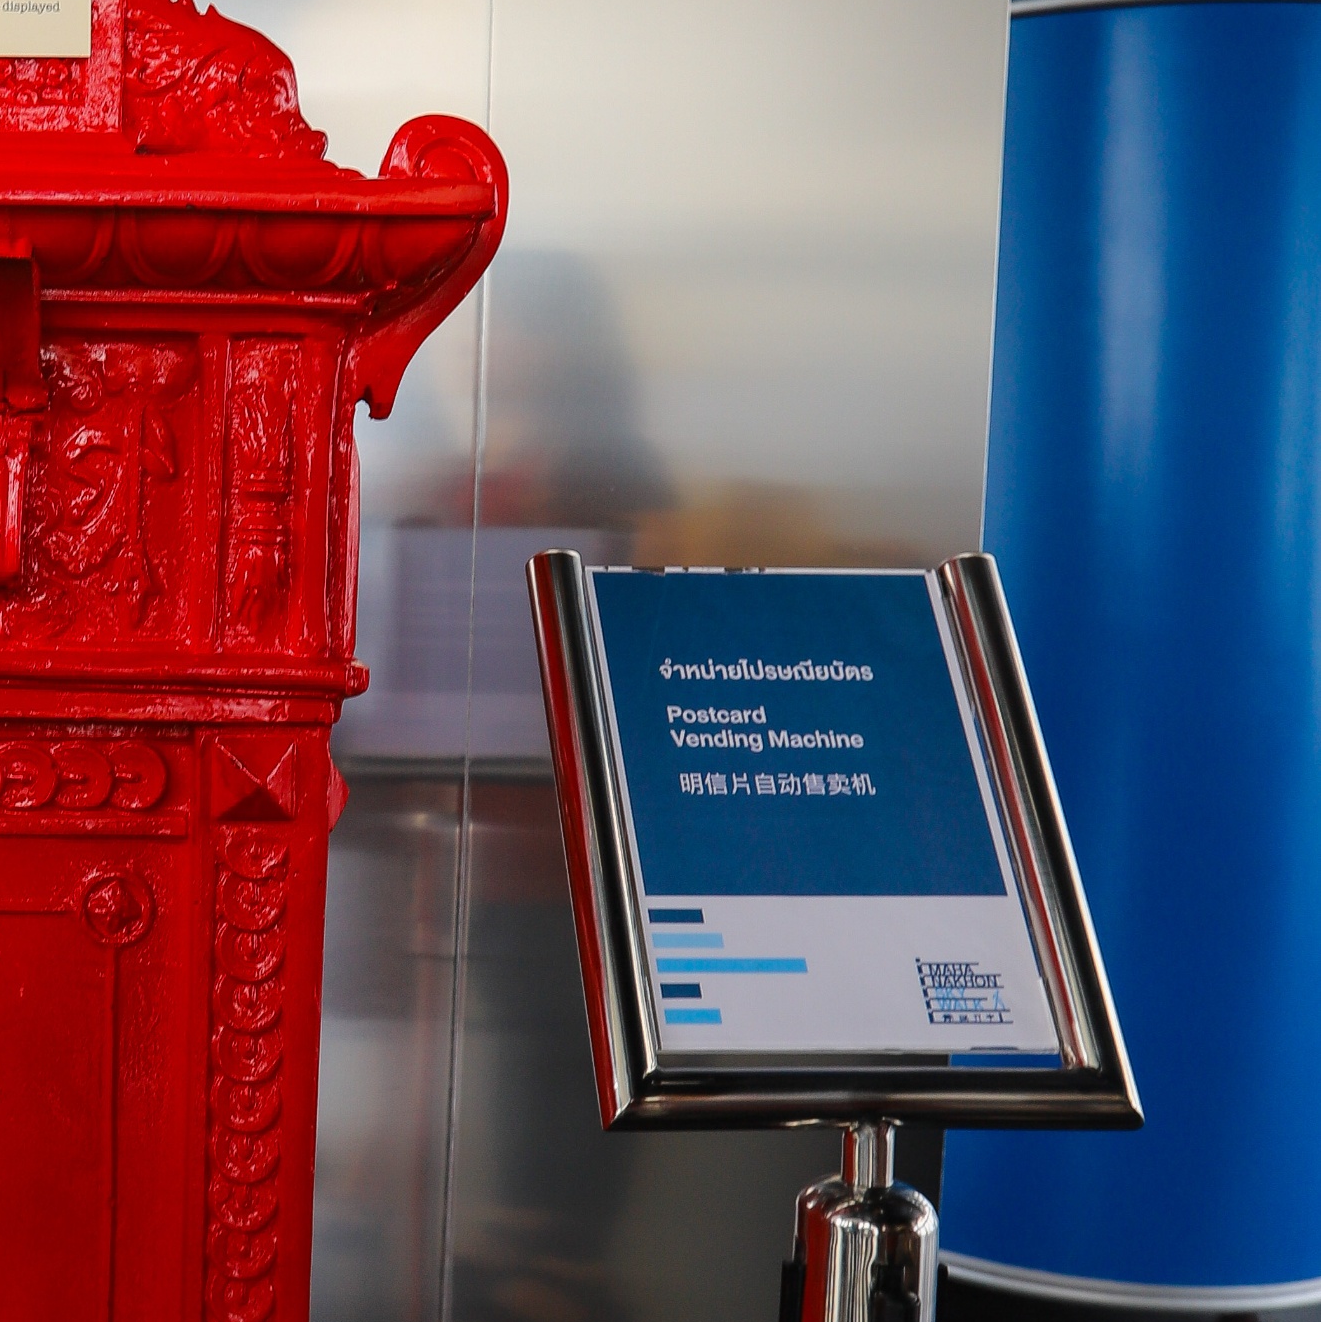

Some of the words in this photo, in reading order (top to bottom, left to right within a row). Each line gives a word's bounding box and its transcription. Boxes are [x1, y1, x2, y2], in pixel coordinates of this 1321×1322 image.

[2, 1, 60, 14] displayed
[666, 705, 767, 724] Postcard
[670, 729, 763, 752] Vending
[768, 730, 865, 749] Machine
[679, 772, 877, 796] 明信片自动售卖机
[928, 963, 975, 975] MAHA
[931, 975, 997, 988] NAKHON
